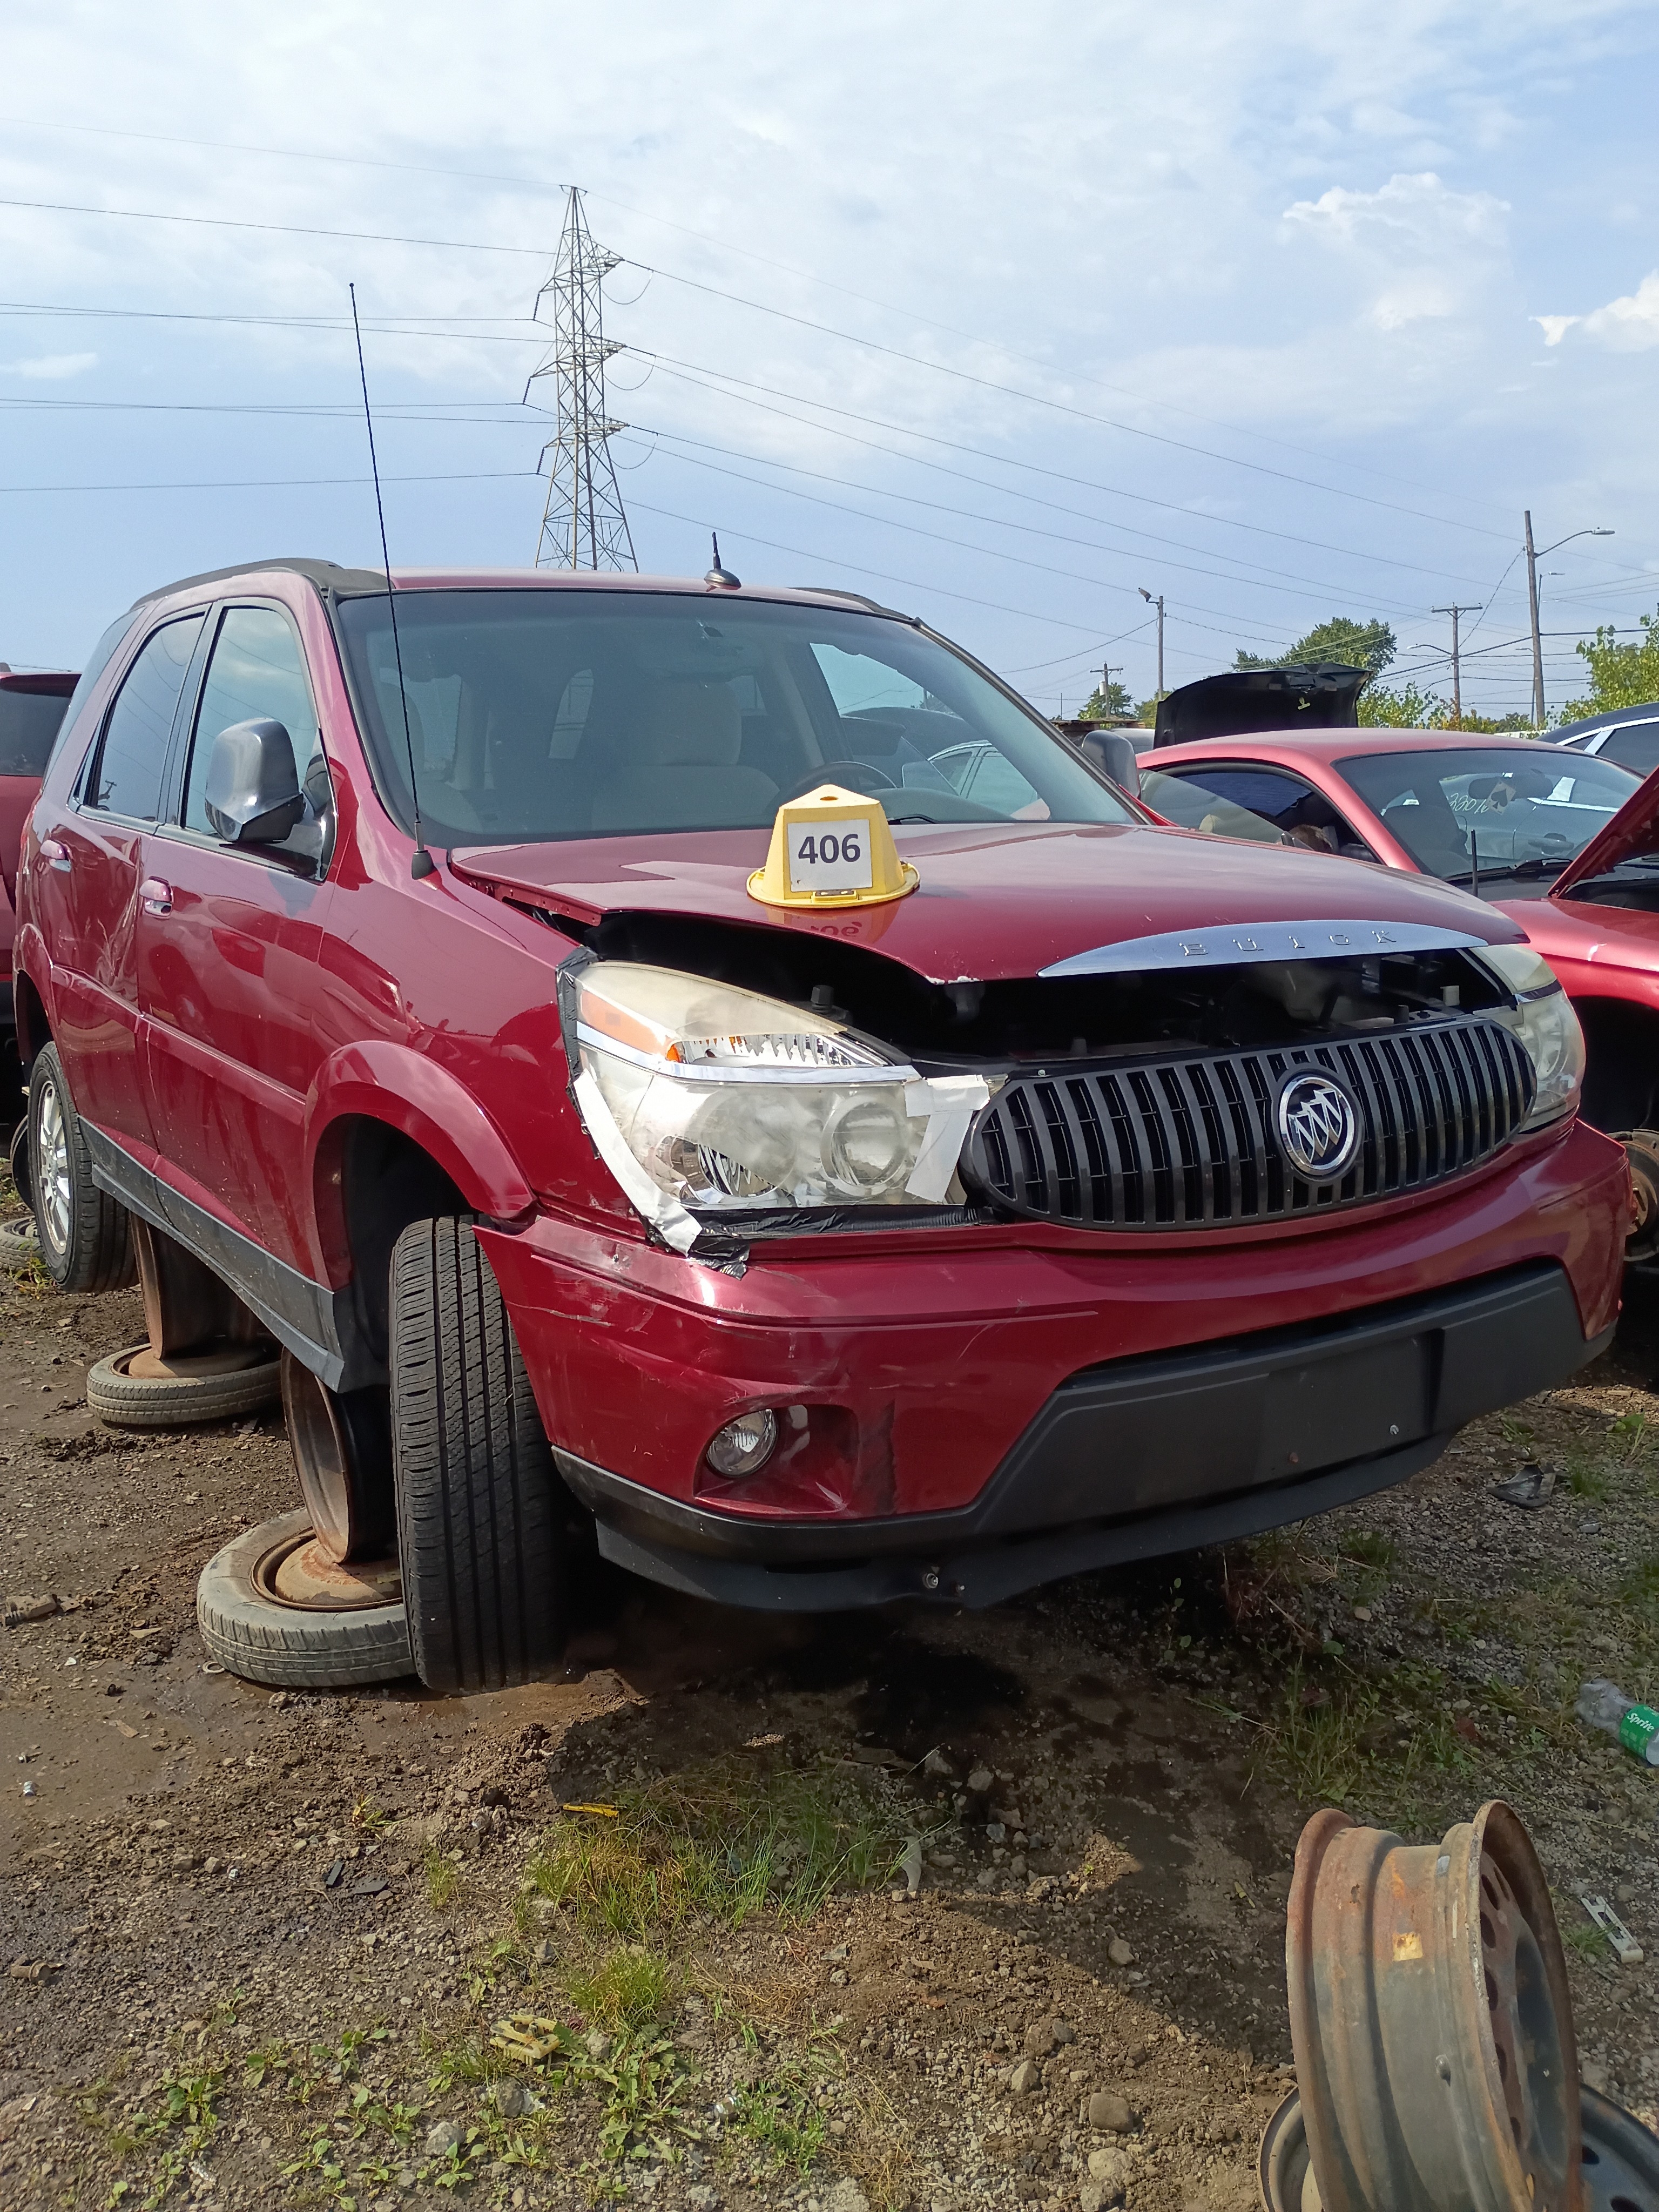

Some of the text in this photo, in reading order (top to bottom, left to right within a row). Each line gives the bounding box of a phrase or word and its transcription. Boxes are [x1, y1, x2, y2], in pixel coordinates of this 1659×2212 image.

[798, 833, 861, 864] 406
[1179, 930, 1397, 956] BUICK
[1627, 1712, 1654, 1732] Sprite
